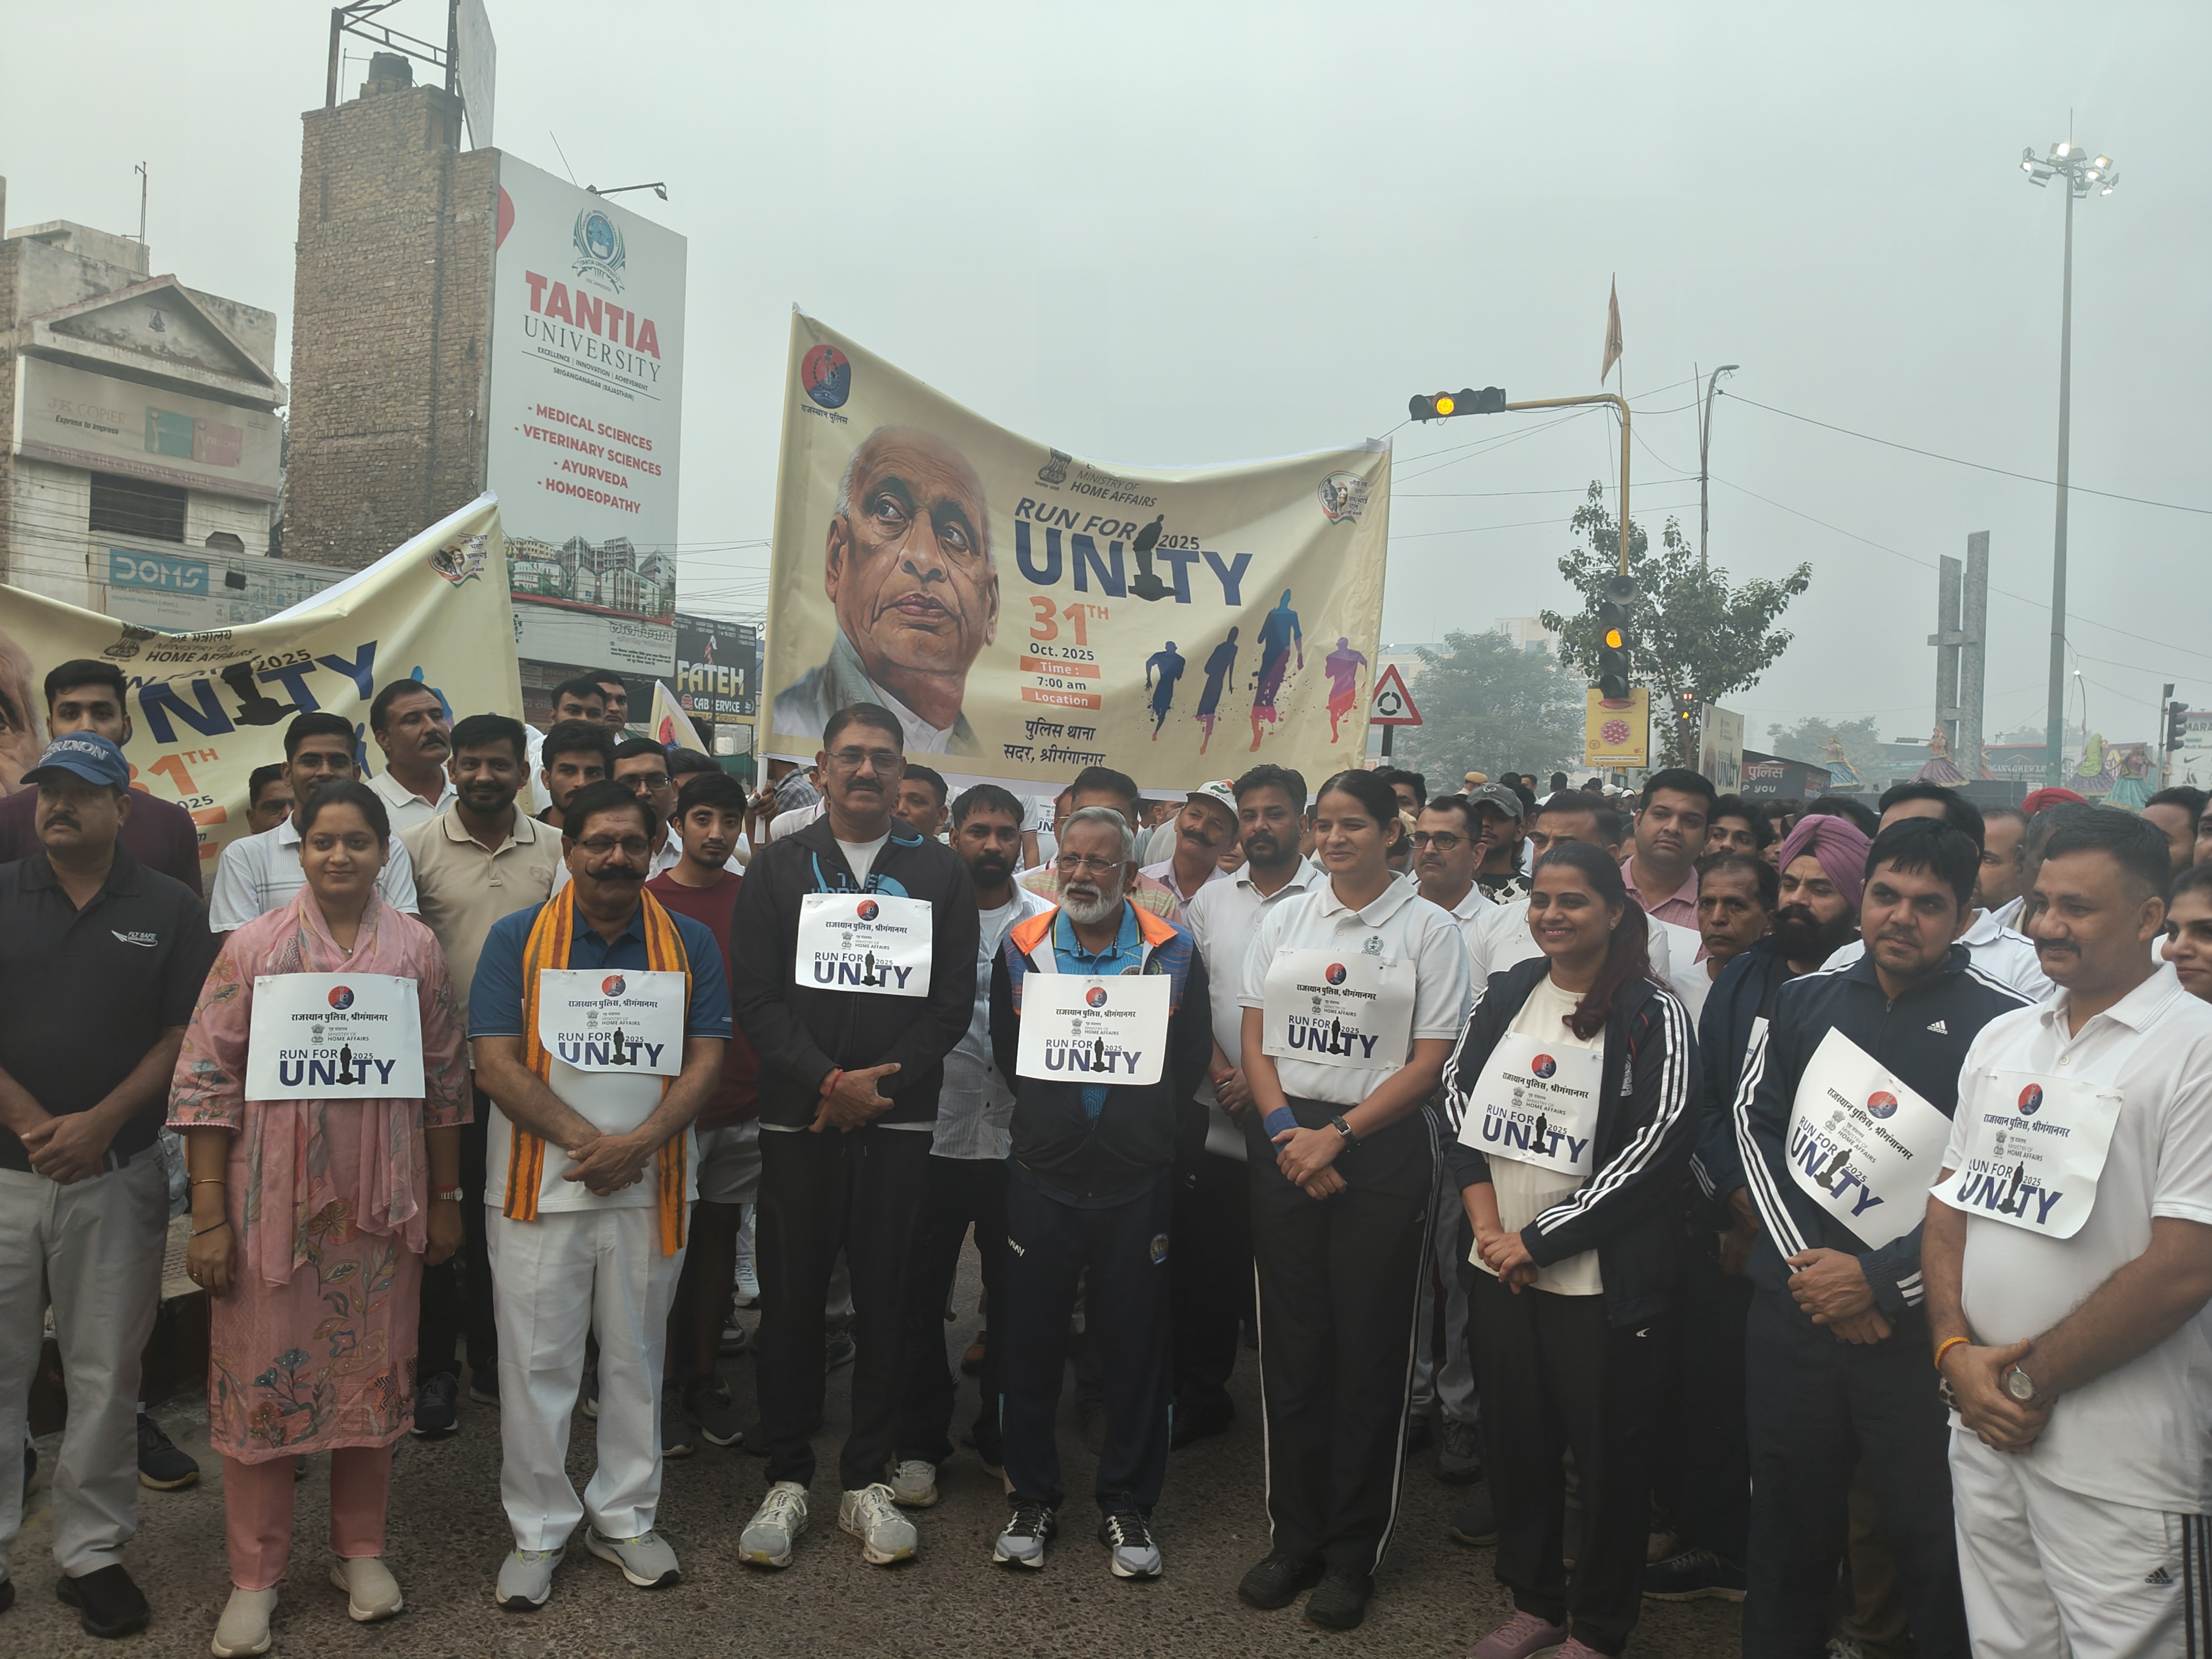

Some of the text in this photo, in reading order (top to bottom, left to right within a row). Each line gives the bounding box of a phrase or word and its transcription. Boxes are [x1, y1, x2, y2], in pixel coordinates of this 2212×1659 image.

[525, 270, 661, 360] TANTIA
[524, 314, 661, 382] UNIVERSITY
[538, 347, 648, 391] EXCELLENCE INNOVATION ACHIEVEMENT
[554, 367, 601, 388] SRIGANGANAGAR
[56, 415, 82, 426] Express
[801, 404, 848, 424] राजस्थान पुलिस
[536, 403, 652, 451] MEDICAL SCIENCES
[523, 424, 662, 476] VETERINARY SCIENCES
[562, 459, 628, 489] AYURVEDA
[1077, 470, 1139, 491] MINISTRY OF
[546, 477, 641, 514] HOMOEOPATHY
[1070, 481, 1110, 499] HOME
[1109, 491, 1157, 507] AFFAIRS
[1015, 497, 1137, 541] RUN FOR
[1157, 534, 1200, 550] 2025
[116, 557, 203, 588] DOMS
[145, 648, 257, 663] HOME AFFAIRS
[256, 649, 312, 672] 2025
[1030, 643, 1095, 660] Oct. 2025
[677, 660, 744, 698] FATEH
[1037, 677, 1086, 690] 7:00 am
[121, 640, 377, 747] NITY
[1035, 691, 1088, 706] Location
[694, 698, 709, 710] CAB
[711, 699, 740, 713] ERVICE
[1025, 717, 1096, 741] पुलिस थाना
[1040, 744, 1106, 767] श्रीगंगानगर
[1748, 764, 1784, 780] पुलिस
[176, 795, 214, 811] 025
[875, 923, 907, 934] श्रीगंगानगर
[815, 952, 864, 962] RUN FOR
[1297, 984, 1321, 993] राजस्थान
[1342, 989, 1377, 1000] श्रीगंगानगर
[623, 999, 658, 1008] श्रीगंगानगर
[1104, 1009, 1136, 1017] श्रीगंगानगर
[351, 1012, 388, 1021] श्रीगंगानगर
[1289, 1015, 1331, 1029] RUN FOR
[558, 1032, 611, 1041] RUN FOR
[1046, 1039, 1092, 1049] RUN FOR
[280, 1049, 338, 1059] RUN FOR
[1502, 1072, 1526, 1085] राजस्थान
[1550, 1083, 1589, 1099] श्रीगंगानगर
[1486, 1104, 1534, 1125] RUN FOR
[1544, 1107, 1566, 1115] AFFAIRS
[1548, 1124, 1567, 1134] 2025
[1827, 1087, 1854, 1111] राजस्थान
[1875, 1126, 1914, 1161] श्रीगंगानगर
[1984, 1114, 2009, 1127] राजस्थान
[2032, 1120, 2071, 1137] श्रीगंगानगर
[1798, 1116, 1838, 1156] RUN FOR
[1838, 1130, 1877, 1163] HOME AFFAIRS
[2007, 1149, 2043, 1162] HOME AFFAIRS
[1845, 1163, 1867, 1183] 2025
[1991, 1163, 2013, 1179] FOR
[2023, 1176, 2041, 1187] 2025
